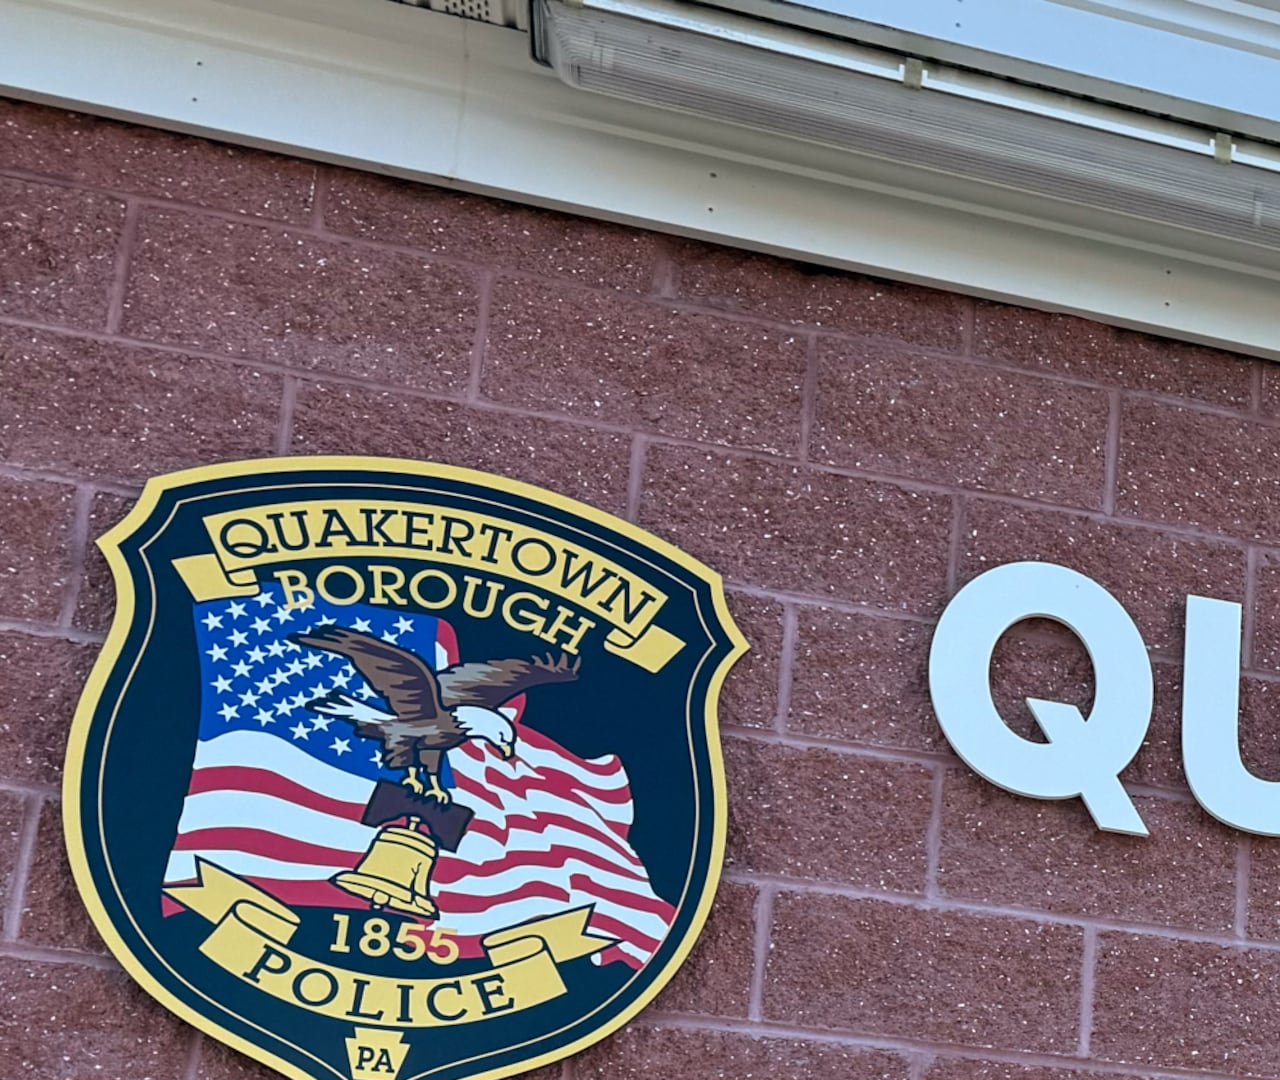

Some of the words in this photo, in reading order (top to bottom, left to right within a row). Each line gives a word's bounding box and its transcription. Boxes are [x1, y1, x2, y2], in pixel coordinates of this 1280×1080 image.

[220, 509, 655, 628] QUAKERTOWN
[274, 564, 596, 655] BOROUGH
[329, 913, 460, 964] 1855
[242, 944, 515, 1024] POLICE
[355, 1045, 395, 1074] PA
